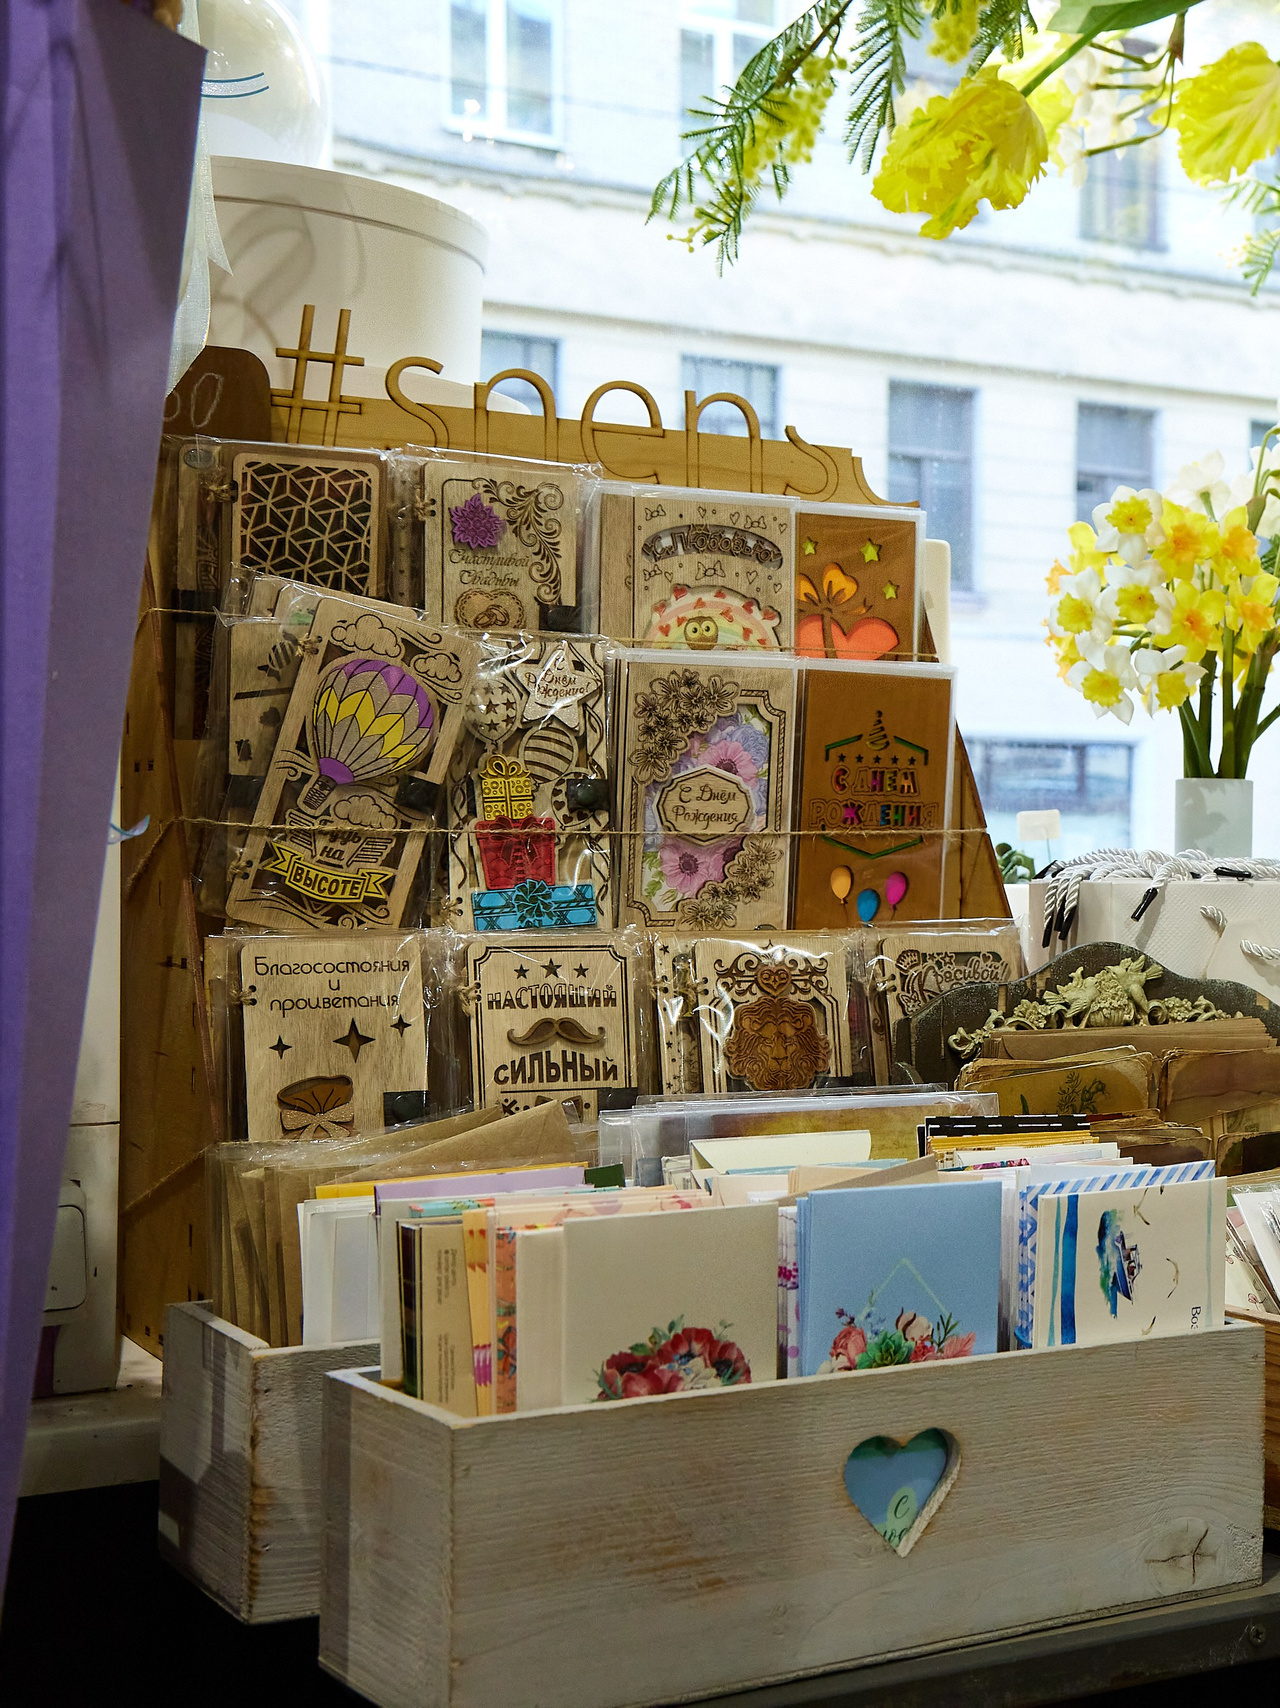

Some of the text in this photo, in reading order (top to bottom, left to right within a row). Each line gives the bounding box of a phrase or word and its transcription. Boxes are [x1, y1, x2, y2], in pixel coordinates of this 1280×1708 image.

[678, 784, 692, 804] С
[830, 765, 920, 797] С ДНЕМ
[671, 805, 738, 831] Рождения
[808, 798, 940, 830] РОЖДЕНИЯ
[319, 845, 345, 861] на
[292, 865, 362, 897] ВЫСОТЕ
[254, 956, 410, 976] Благосостояния
[328, 979, 341, 991] и
[487, 982, 618, 1010] НАСТОЯЩИЙ
[270, 995, 399, 1018] процветания
[493, 1049, 619, 1086] СИЛЬНЫЙ
